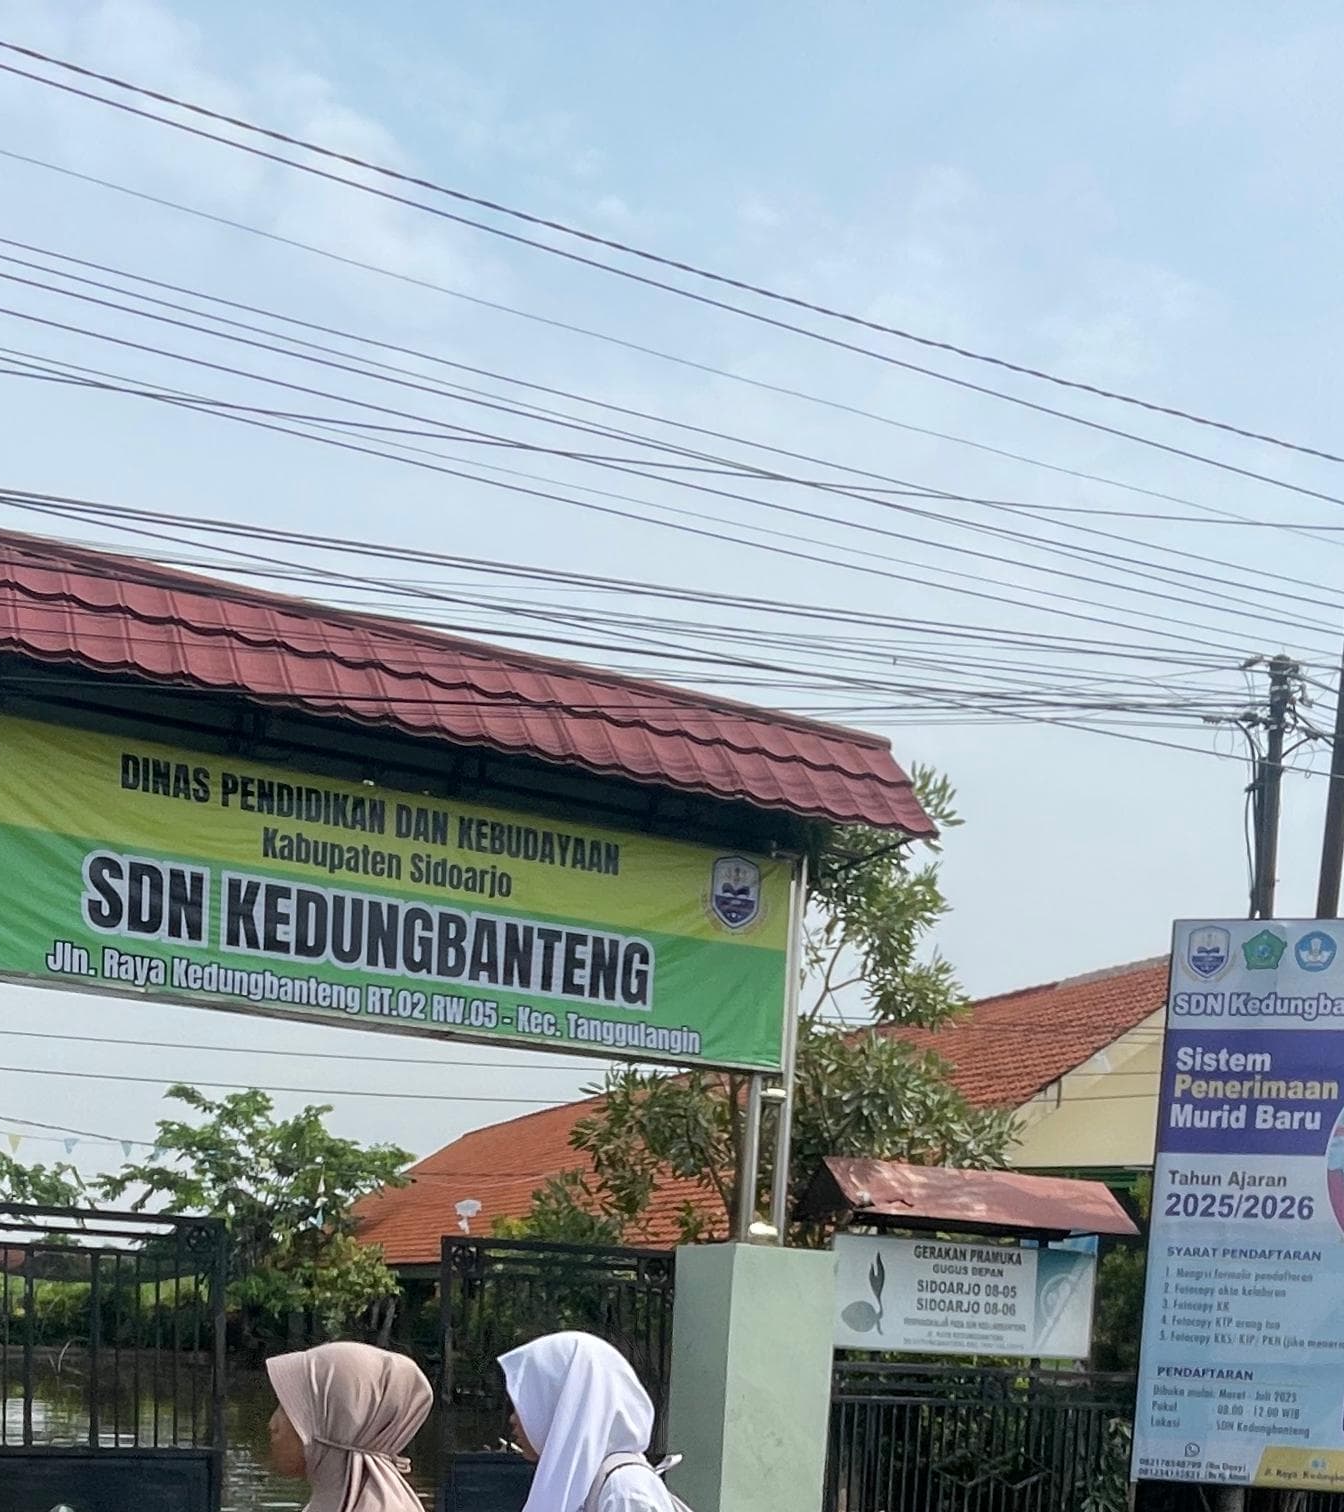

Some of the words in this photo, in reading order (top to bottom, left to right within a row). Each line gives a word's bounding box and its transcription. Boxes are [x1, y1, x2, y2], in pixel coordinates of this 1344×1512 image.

[121, 753, 210, 803] DINAS
[221, 772, 385, 834] PENDIDIKAN
[395, 803, 449, 846] DAN
[458, 815, 620, 876] KEBUDAYAAN
[262, 826, 402, 880] Kabupaten
[410, 853, 513, 899] Sidoarjo
[86, 854, 206, 944] SDN
[225, 876, 651, 1007] KEDUNGBANTENG
[46, 940, 96, 976] Jln.
[104, 948, 167, 986] Raya
[171, 957, 362, 1014] Kedungbanteng
[366, 984, 426, 1019] RT.02
[431, 993, 499, 1028] RW.05
[516, 1005, 562, 1037] Kec.
[566, 1011, 702, 1055] Tanggulangin
[1173, 992, 1225, 1016] SDN
[1175, 1047, 1272, 1072] Sistem
[1173, 1073, 1339, 1100] Penerimaan
[1169, 1103, 1247, 1129] Murid
[1255, 1105, 1321, 1130] Baru
[1168, 1169, 1222, 1187] Tahun
[1227, 1171, 1287, 1191] Ajaran
[1164, 1192, 1314, 1220] 2025/2026
[913, 1245, 967, 1261] GERAKAN
[970, 1249, 1022, 1265] PRAMUKA
[1167, 1246, 1218, 1259] SYARAT
[1221, 1248, 1321, 1262] PENDAFTARAN
[932, 1264, 968, 1275] GUGUS
[971, 1266, 1004, 1277] DEPAN
[917, 1280, 981, 1296] SIDOARJO
[985, 1284, 1017, 1299] 08-05
[916, 1298, 980, 1313] SIDOARJO
[984, 1302, 1016, 1316] 08-06
[1157, 1366, 1254, 1381] PENDAFTARAN
